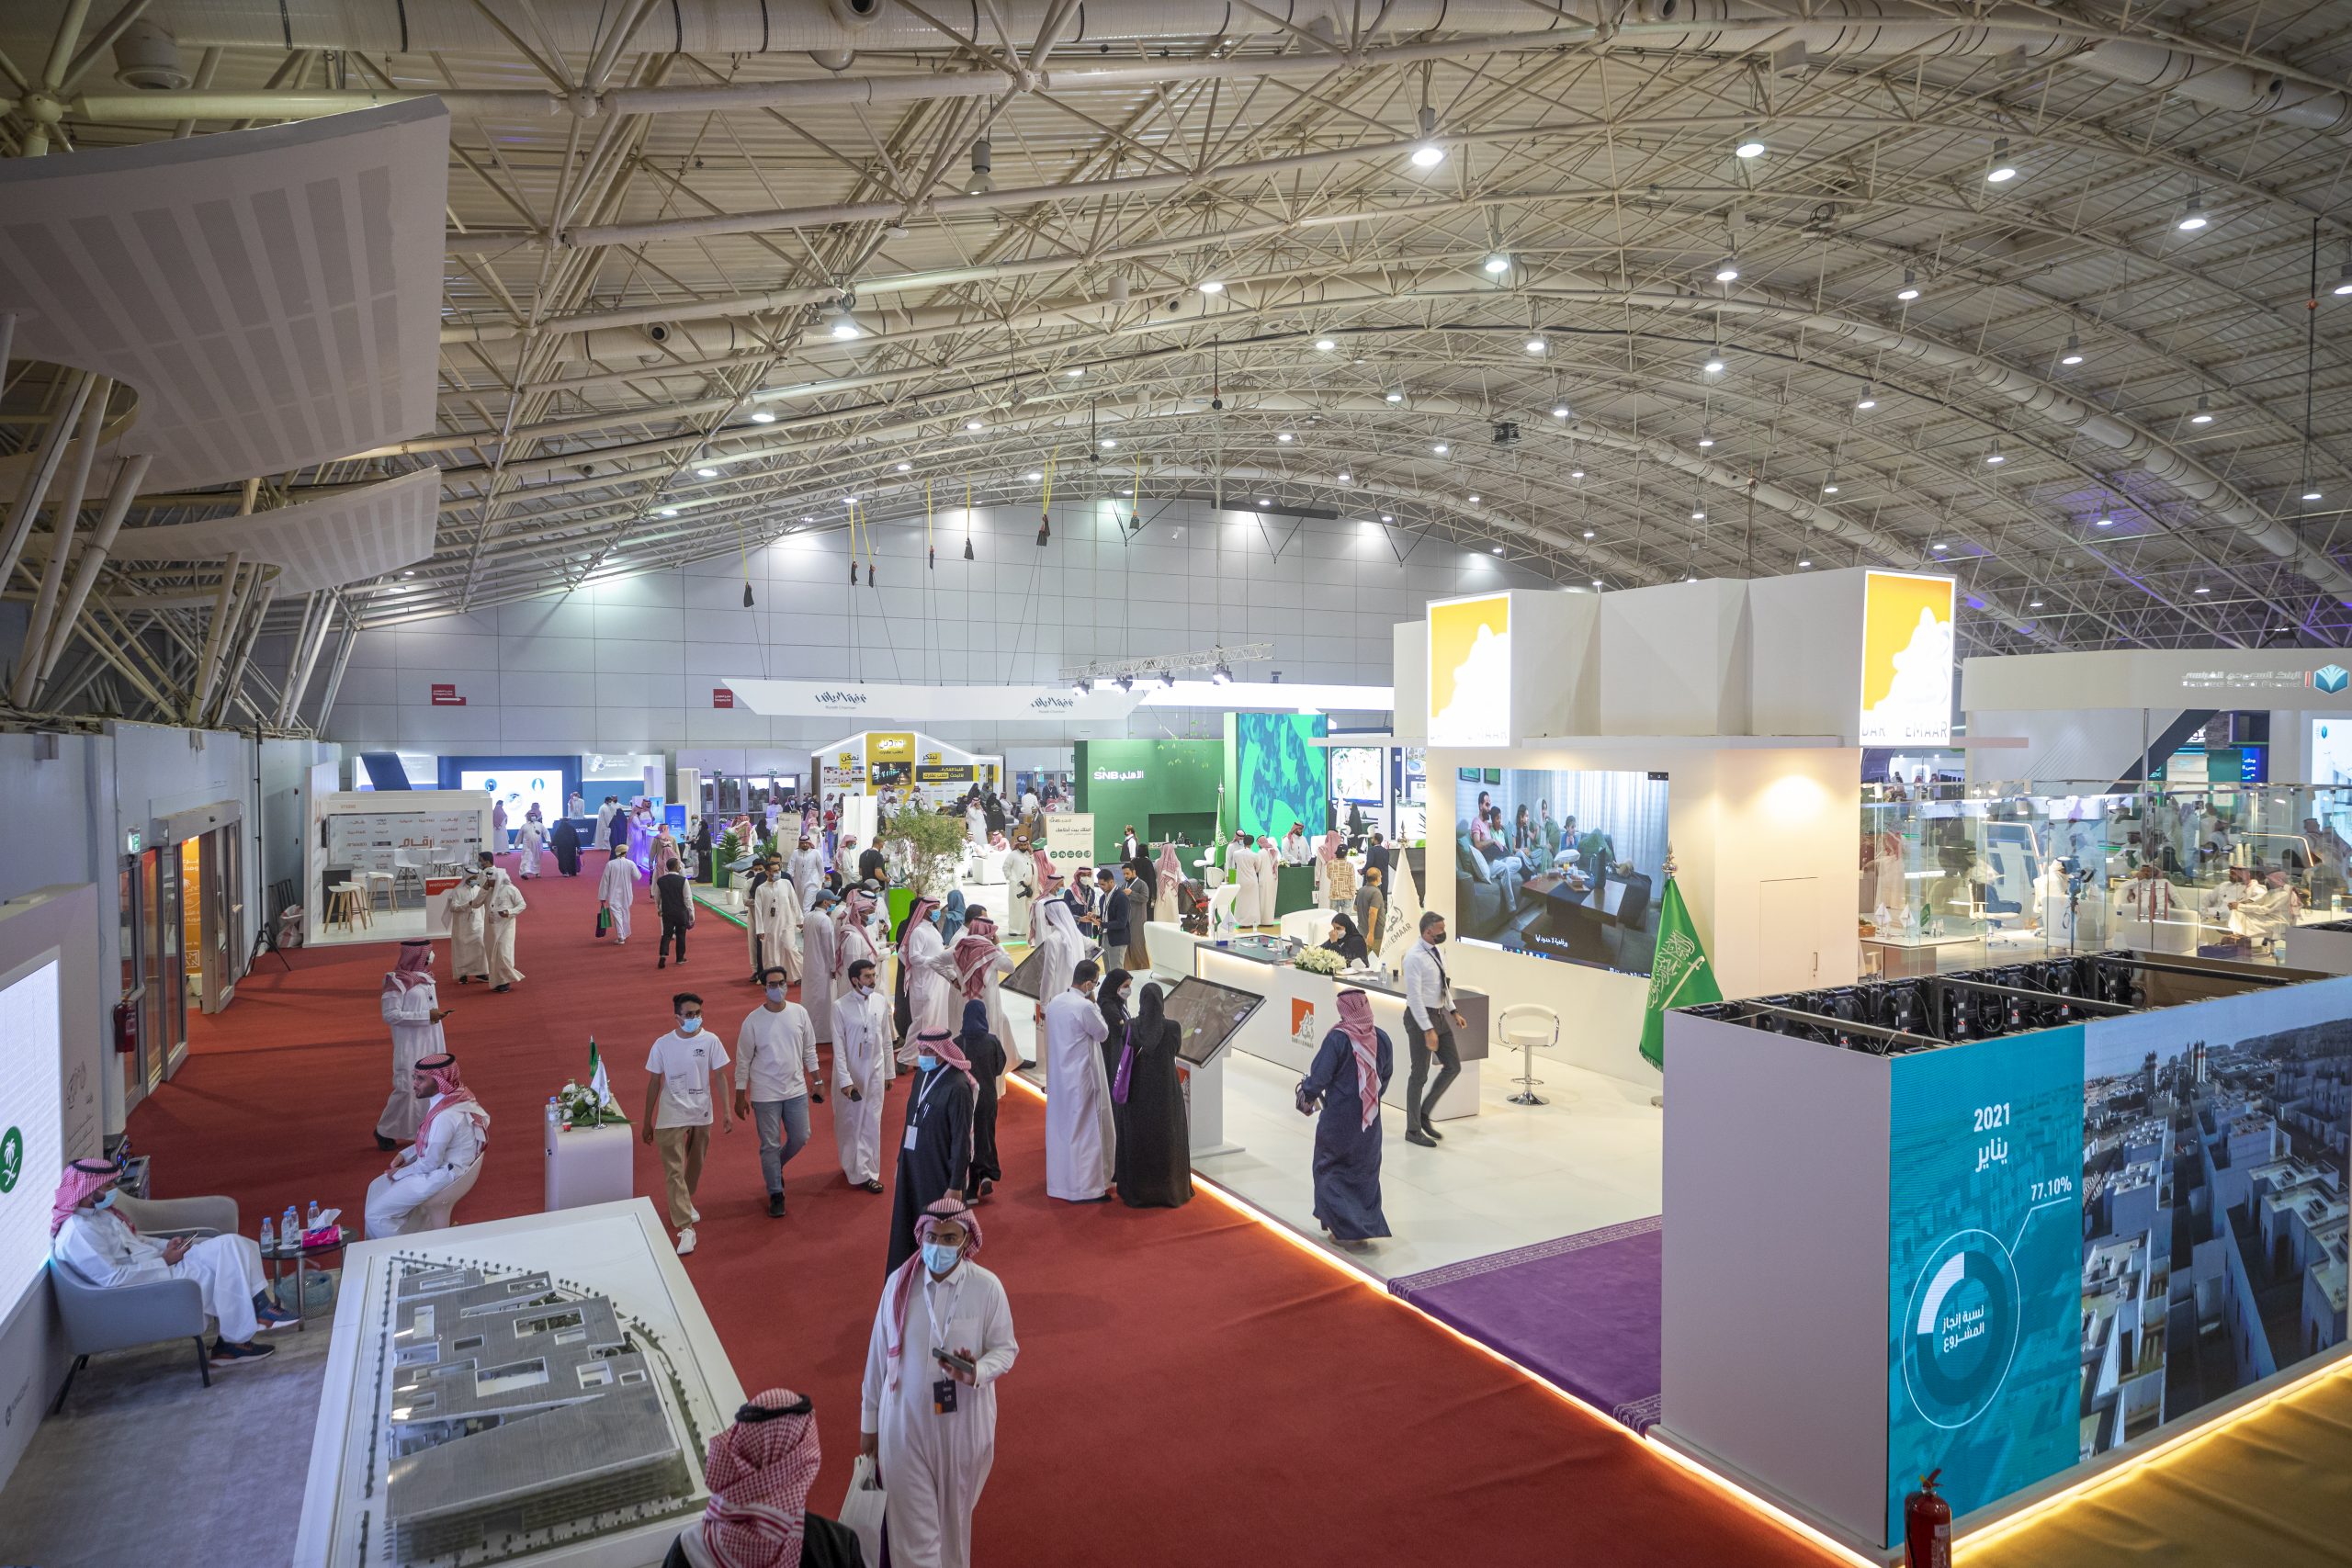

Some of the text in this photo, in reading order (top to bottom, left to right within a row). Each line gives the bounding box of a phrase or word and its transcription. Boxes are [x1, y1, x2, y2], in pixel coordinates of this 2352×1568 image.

[1093, 771, 1119, 780] SNB
[1391, 922, 1413, 944] EMAAR
[1973, 1102, 2010, 1133] 2021
[1974, 1136, 2008, 1173] يناير
[2030, 1175, 2073, 1202] 77.10%
[1941, 1303, 1984, 1335] نسبة إنجاز
[1943, 1321, 1984, 1353] المشروع
